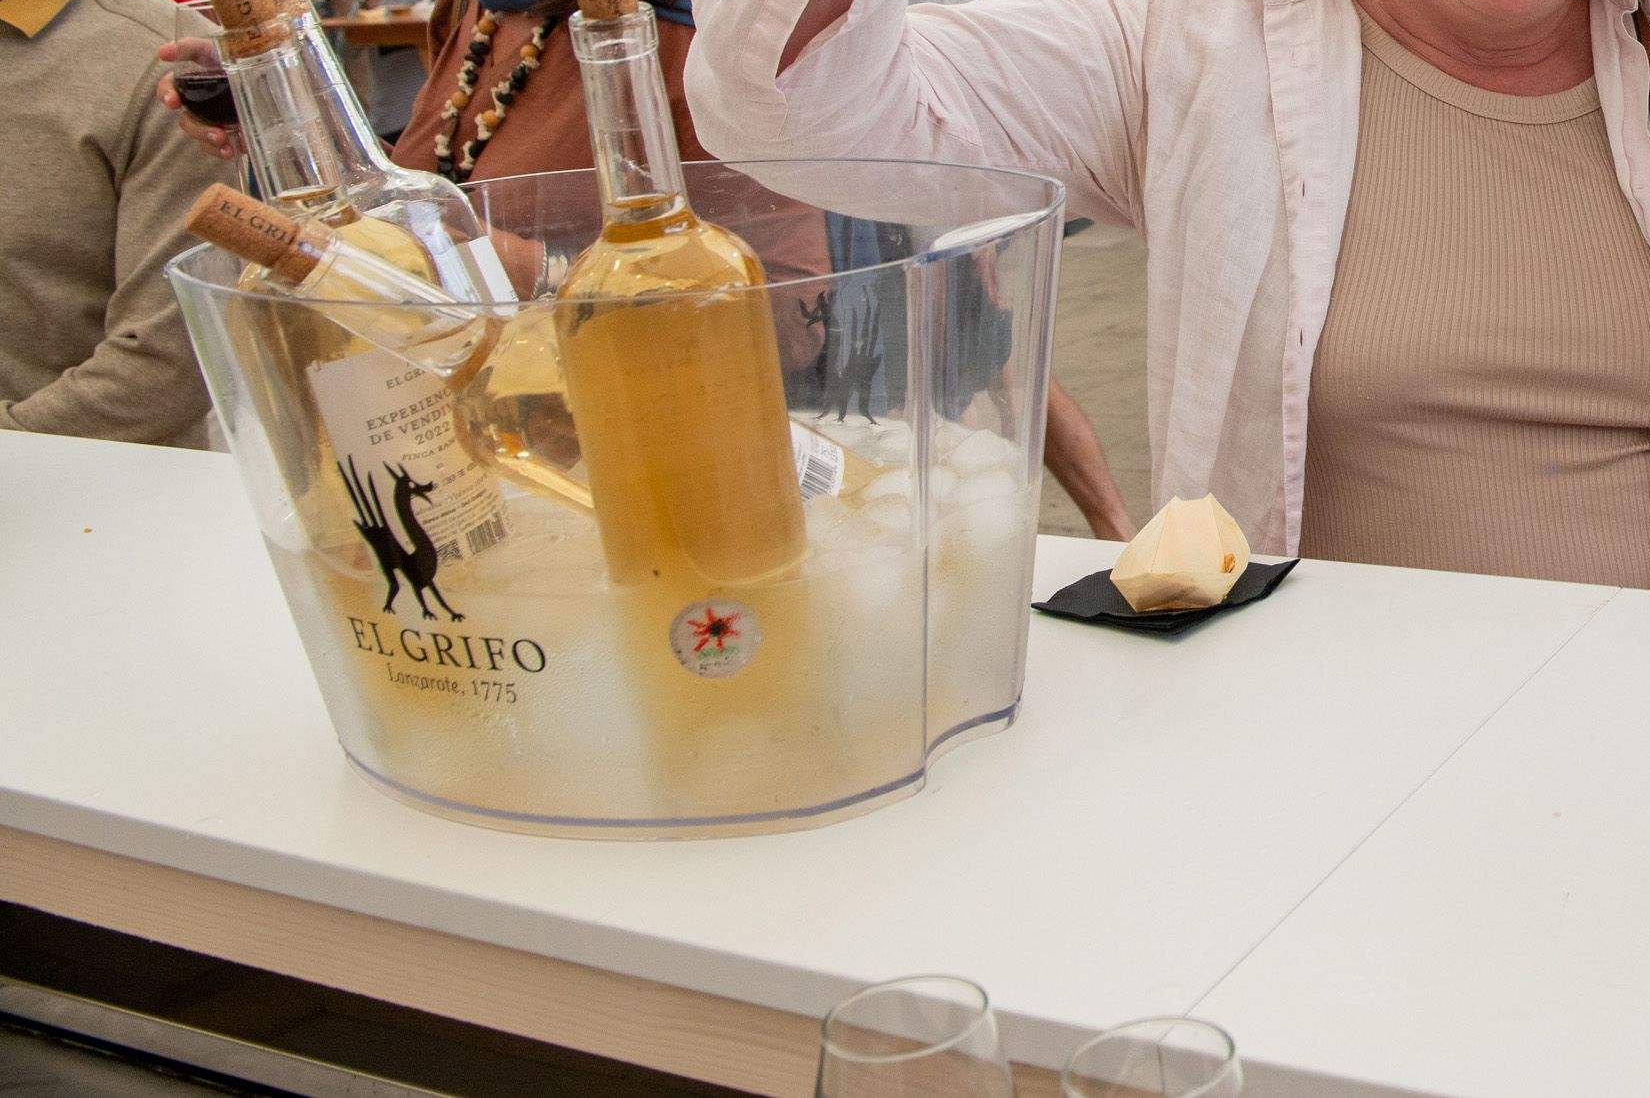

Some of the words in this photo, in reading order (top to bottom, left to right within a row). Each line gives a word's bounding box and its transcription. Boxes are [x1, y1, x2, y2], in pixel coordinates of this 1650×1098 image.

[366, 385, 452, 431] EXPERIENC
[368, 431, 394, 446] DE
[399, 404, 452, 435] VENDI
[414, 420, 451, 446] 2022
[347, 616, 395, 657] EL
[400, 628, 547, 673] GRIFO
[386, 662, 466, 697] Lanzarote,
[471, 679, 518, 704] 1775
